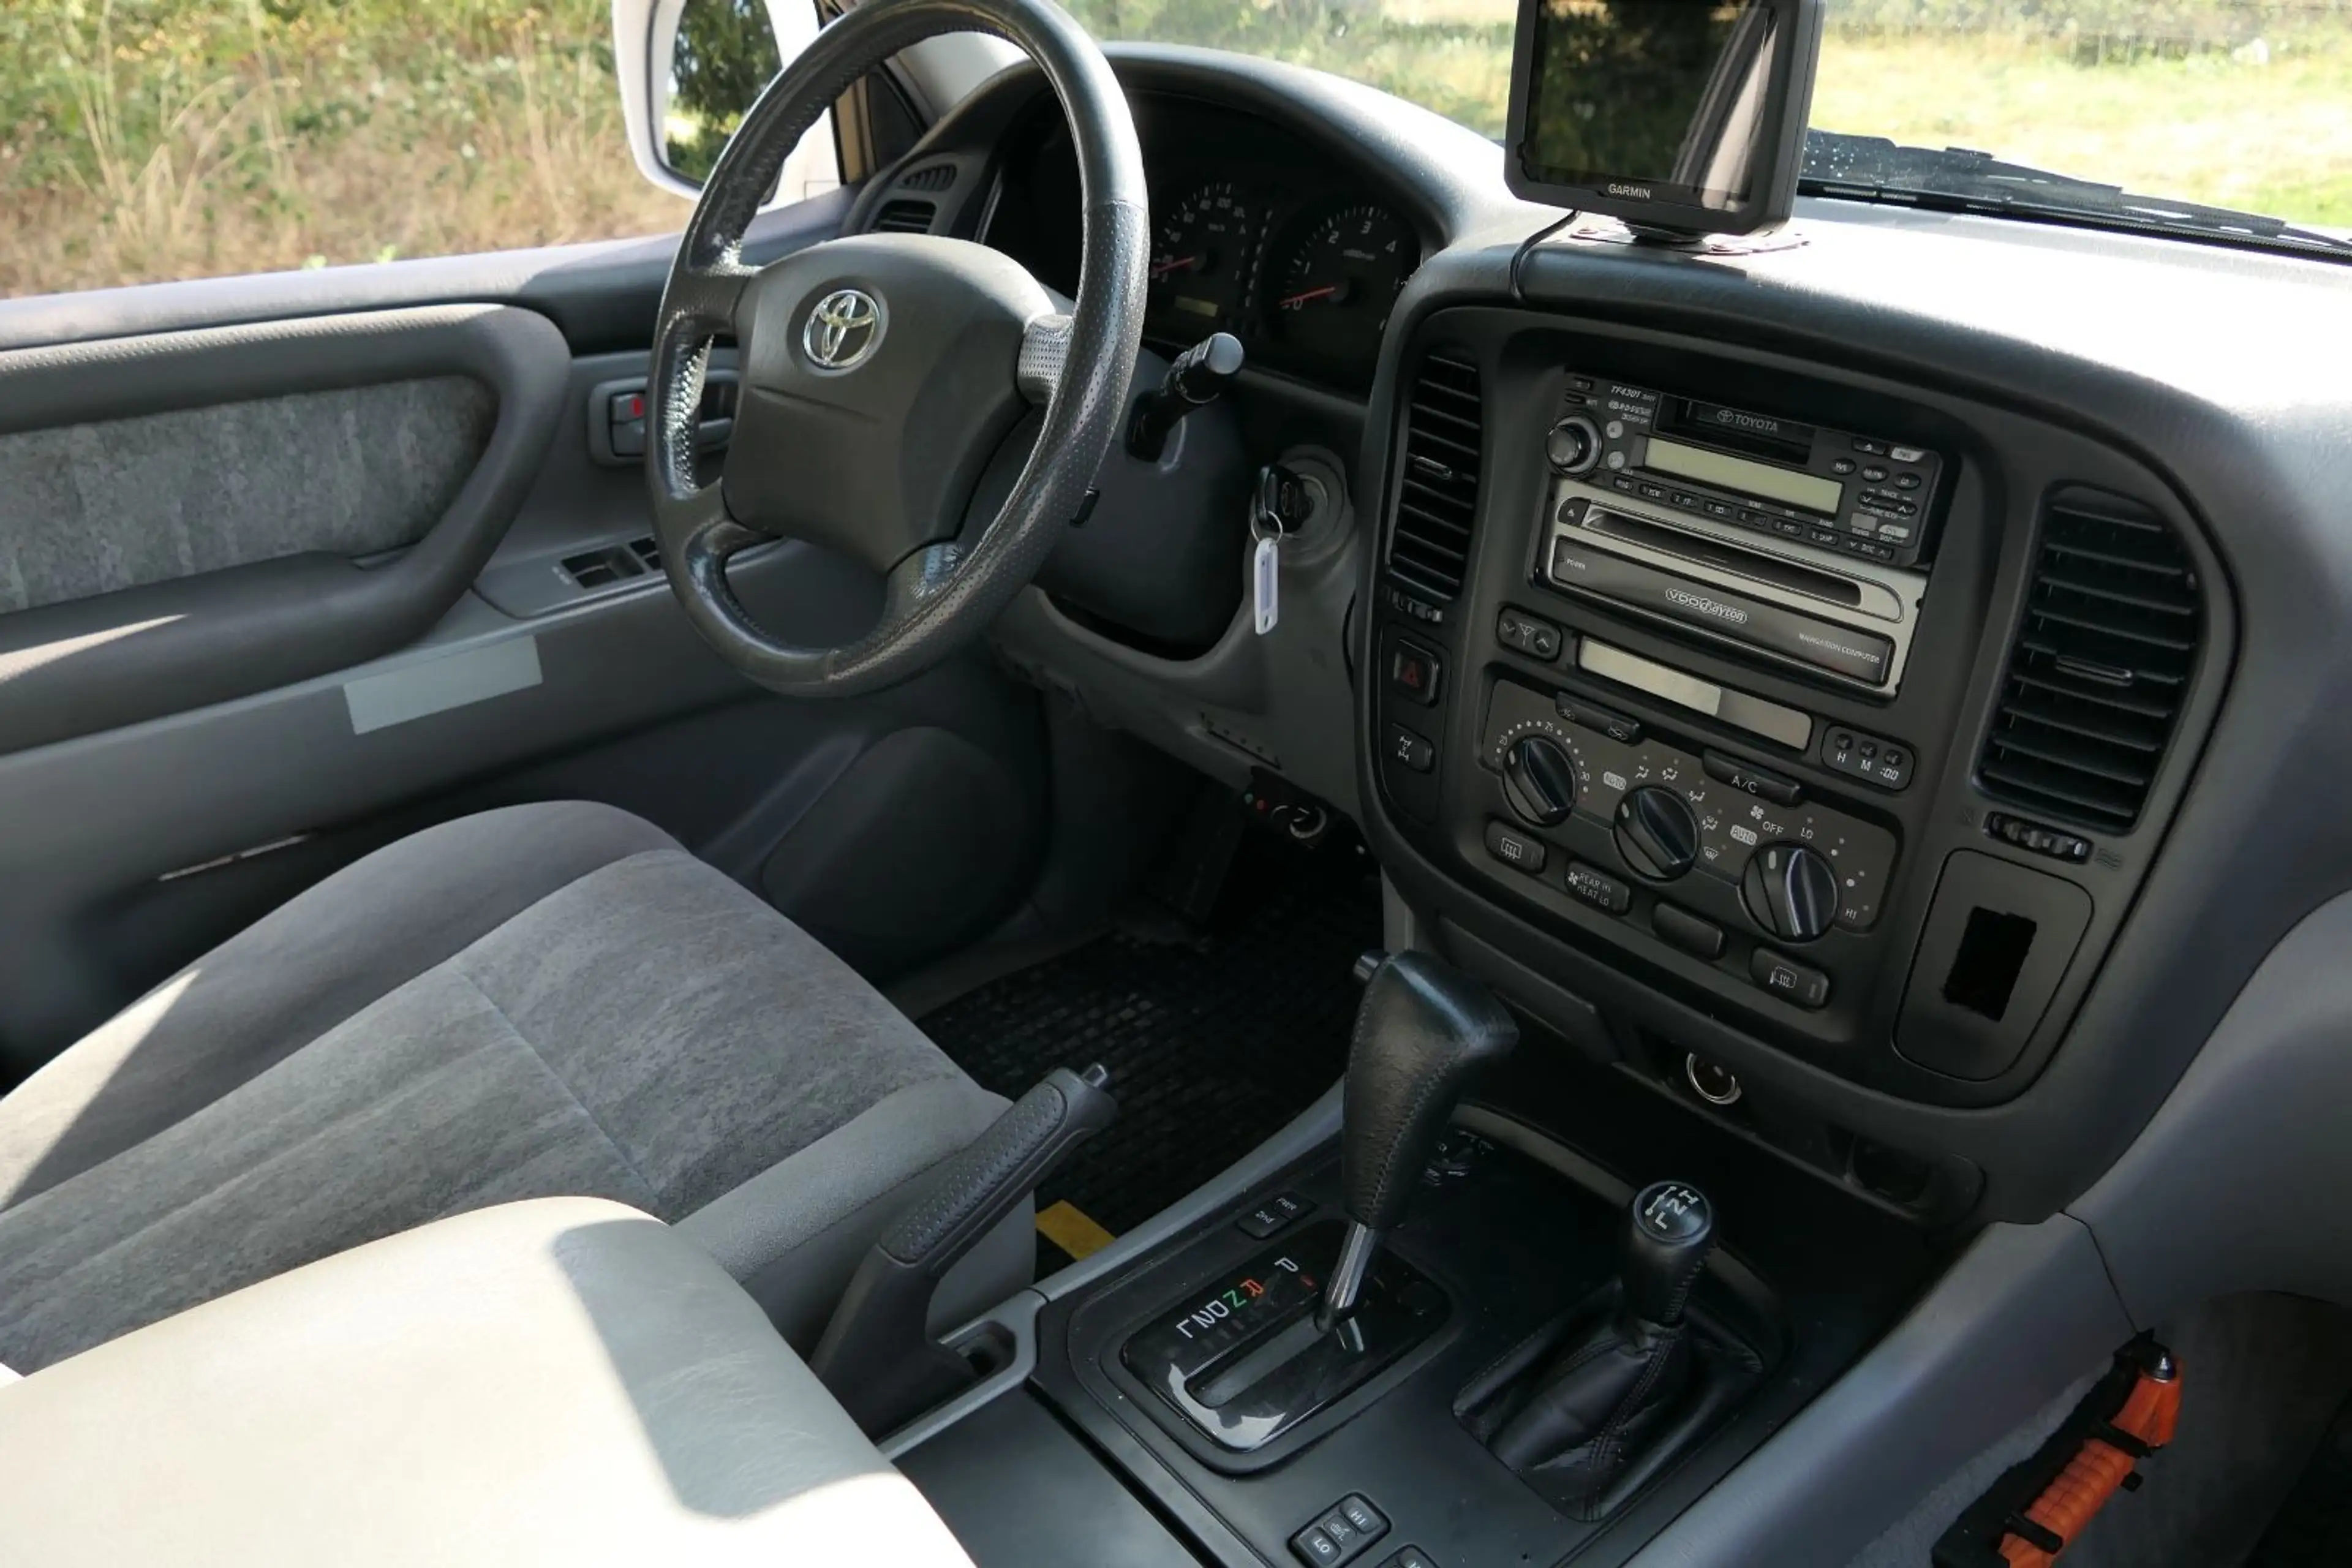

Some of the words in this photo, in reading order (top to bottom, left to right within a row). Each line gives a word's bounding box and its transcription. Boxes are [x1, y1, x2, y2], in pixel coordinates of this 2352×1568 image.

[1608, 183, 1651, 199] GARMIN
[1360, 221, 1372, 234] 3
[1328, 230, 1340, 244] 2
[1385, 239, 1397, 253] 4
[1734, 413, 1777, 432] TOYOTA
[1799, 632, 1841, 652] NAVIGATION
[1842, 646, 1880, 664] COMPUTER
[1838, 752, 1846, 763] H
[1860, 760, 1871, 771] M
[1732, 775, 1758, 793] A/C
[1731, 825, 1757, 845] AUTO
[1762, 821, 1784, 836] OFF
[1801, 827, 1814, 839] LO
[1845, 908, 1857, 920] HI
[1276, 1197, 1298, 1210] PWR
[1274, 1257, 1298, 1272] P
[1240, 1279, 1264, 1297] R
[1223, 1289, 1248, 1308] N
[1205, 1300, 1230, 1317] D
[1191, 1310, 1216, 1329] 2
[1175, 1319, 1193, 1339] L
[1351, 1508, 1366, 1526] HI
[1313, 1537, 1330, 1554] LO
